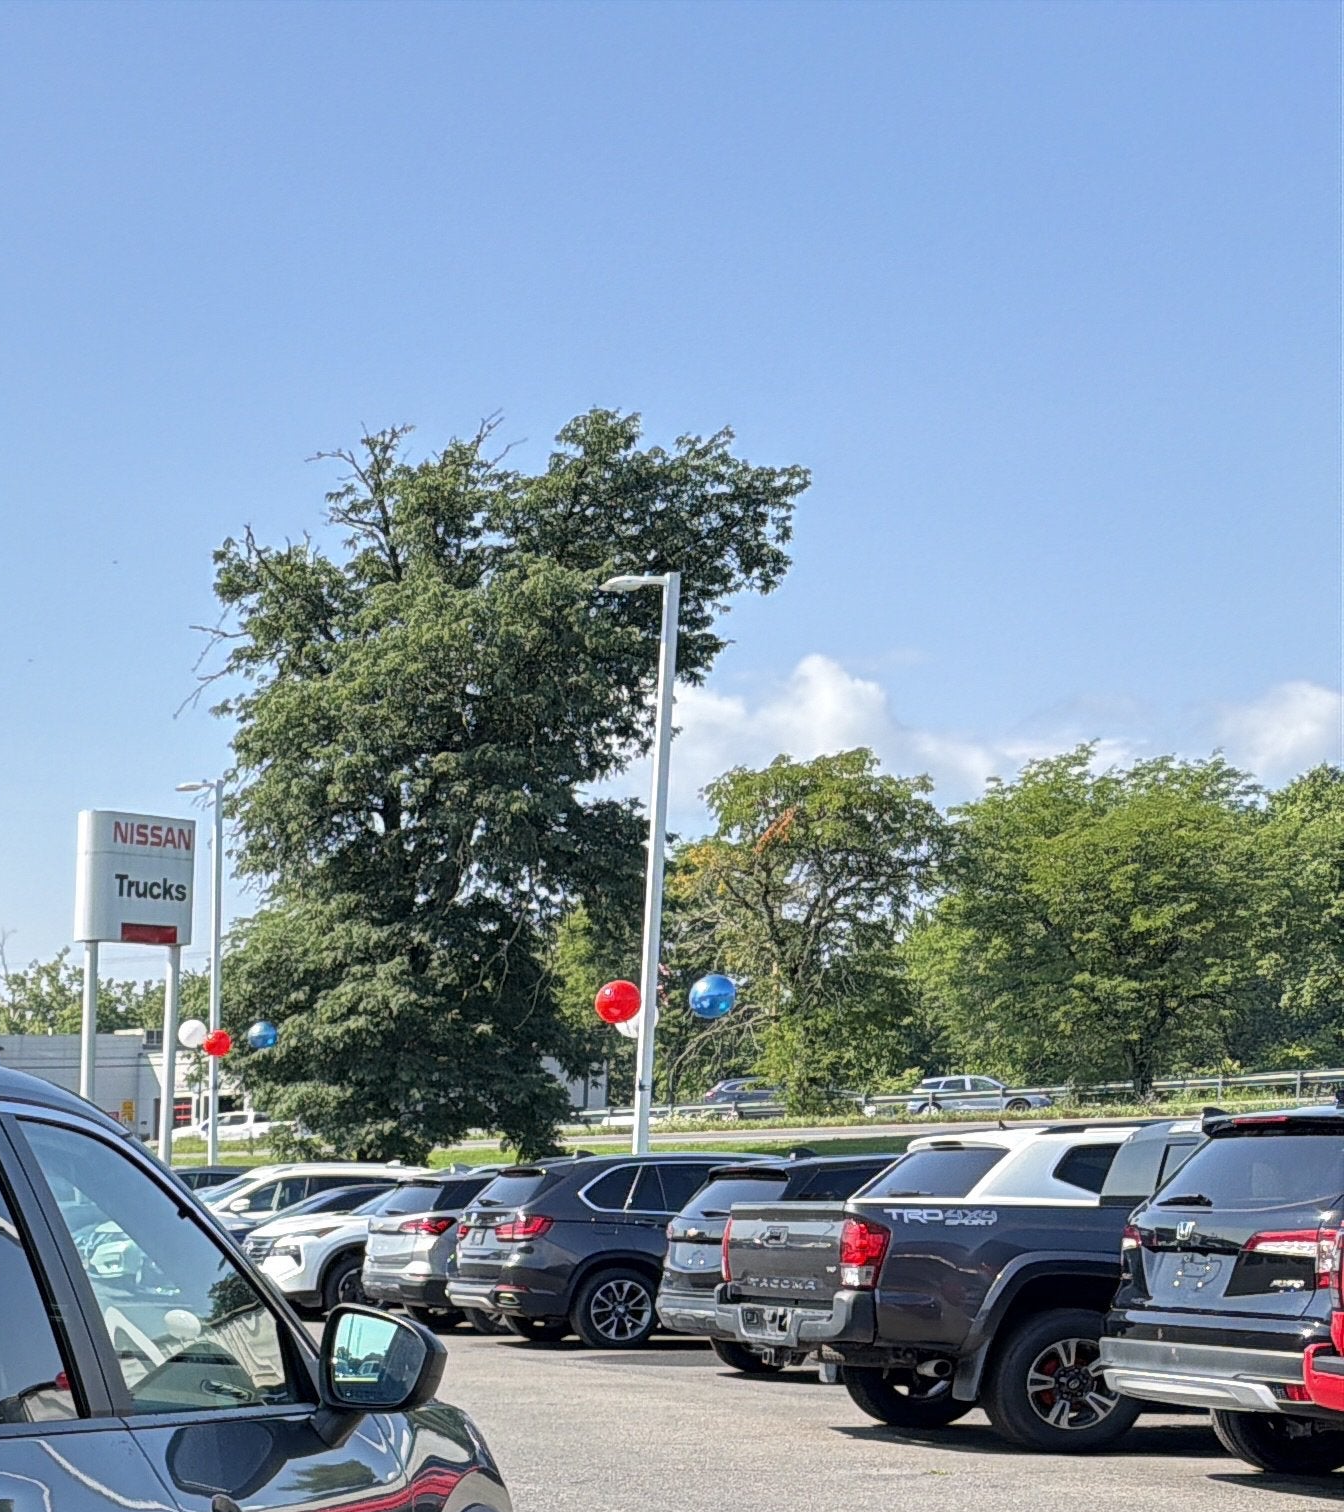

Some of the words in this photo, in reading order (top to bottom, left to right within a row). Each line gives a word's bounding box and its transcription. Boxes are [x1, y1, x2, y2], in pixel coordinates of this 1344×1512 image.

[113, 821, 192, 851] NISSAN
[115, 873, 187, 902] Trucks
[883, 1208, 944, 1224] TRD
[749, 1277, 817, 1291] TACOMA
